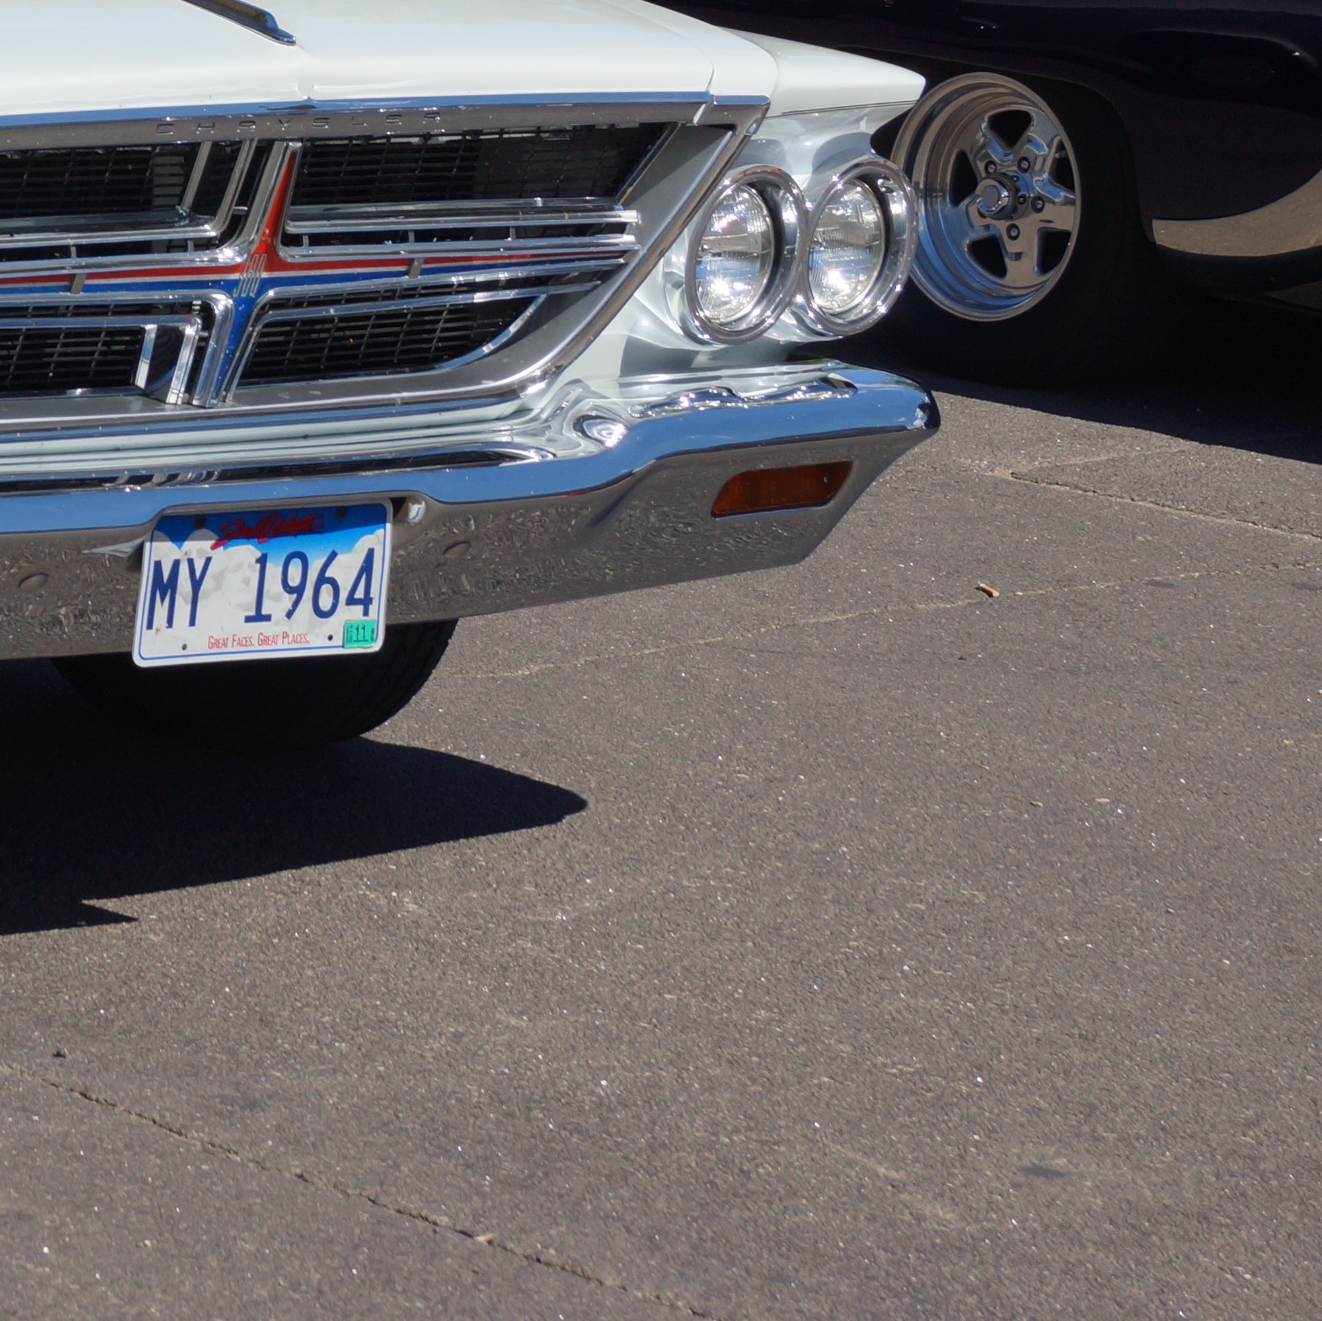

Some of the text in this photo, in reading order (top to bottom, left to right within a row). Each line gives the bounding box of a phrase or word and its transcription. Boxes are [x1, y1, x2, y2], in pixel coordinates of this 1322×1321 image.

[156, 112, 442, 134] CHRYSLER
[233, 253, 268, 297] 300
[146, 547, 375, 631] MY 1964
